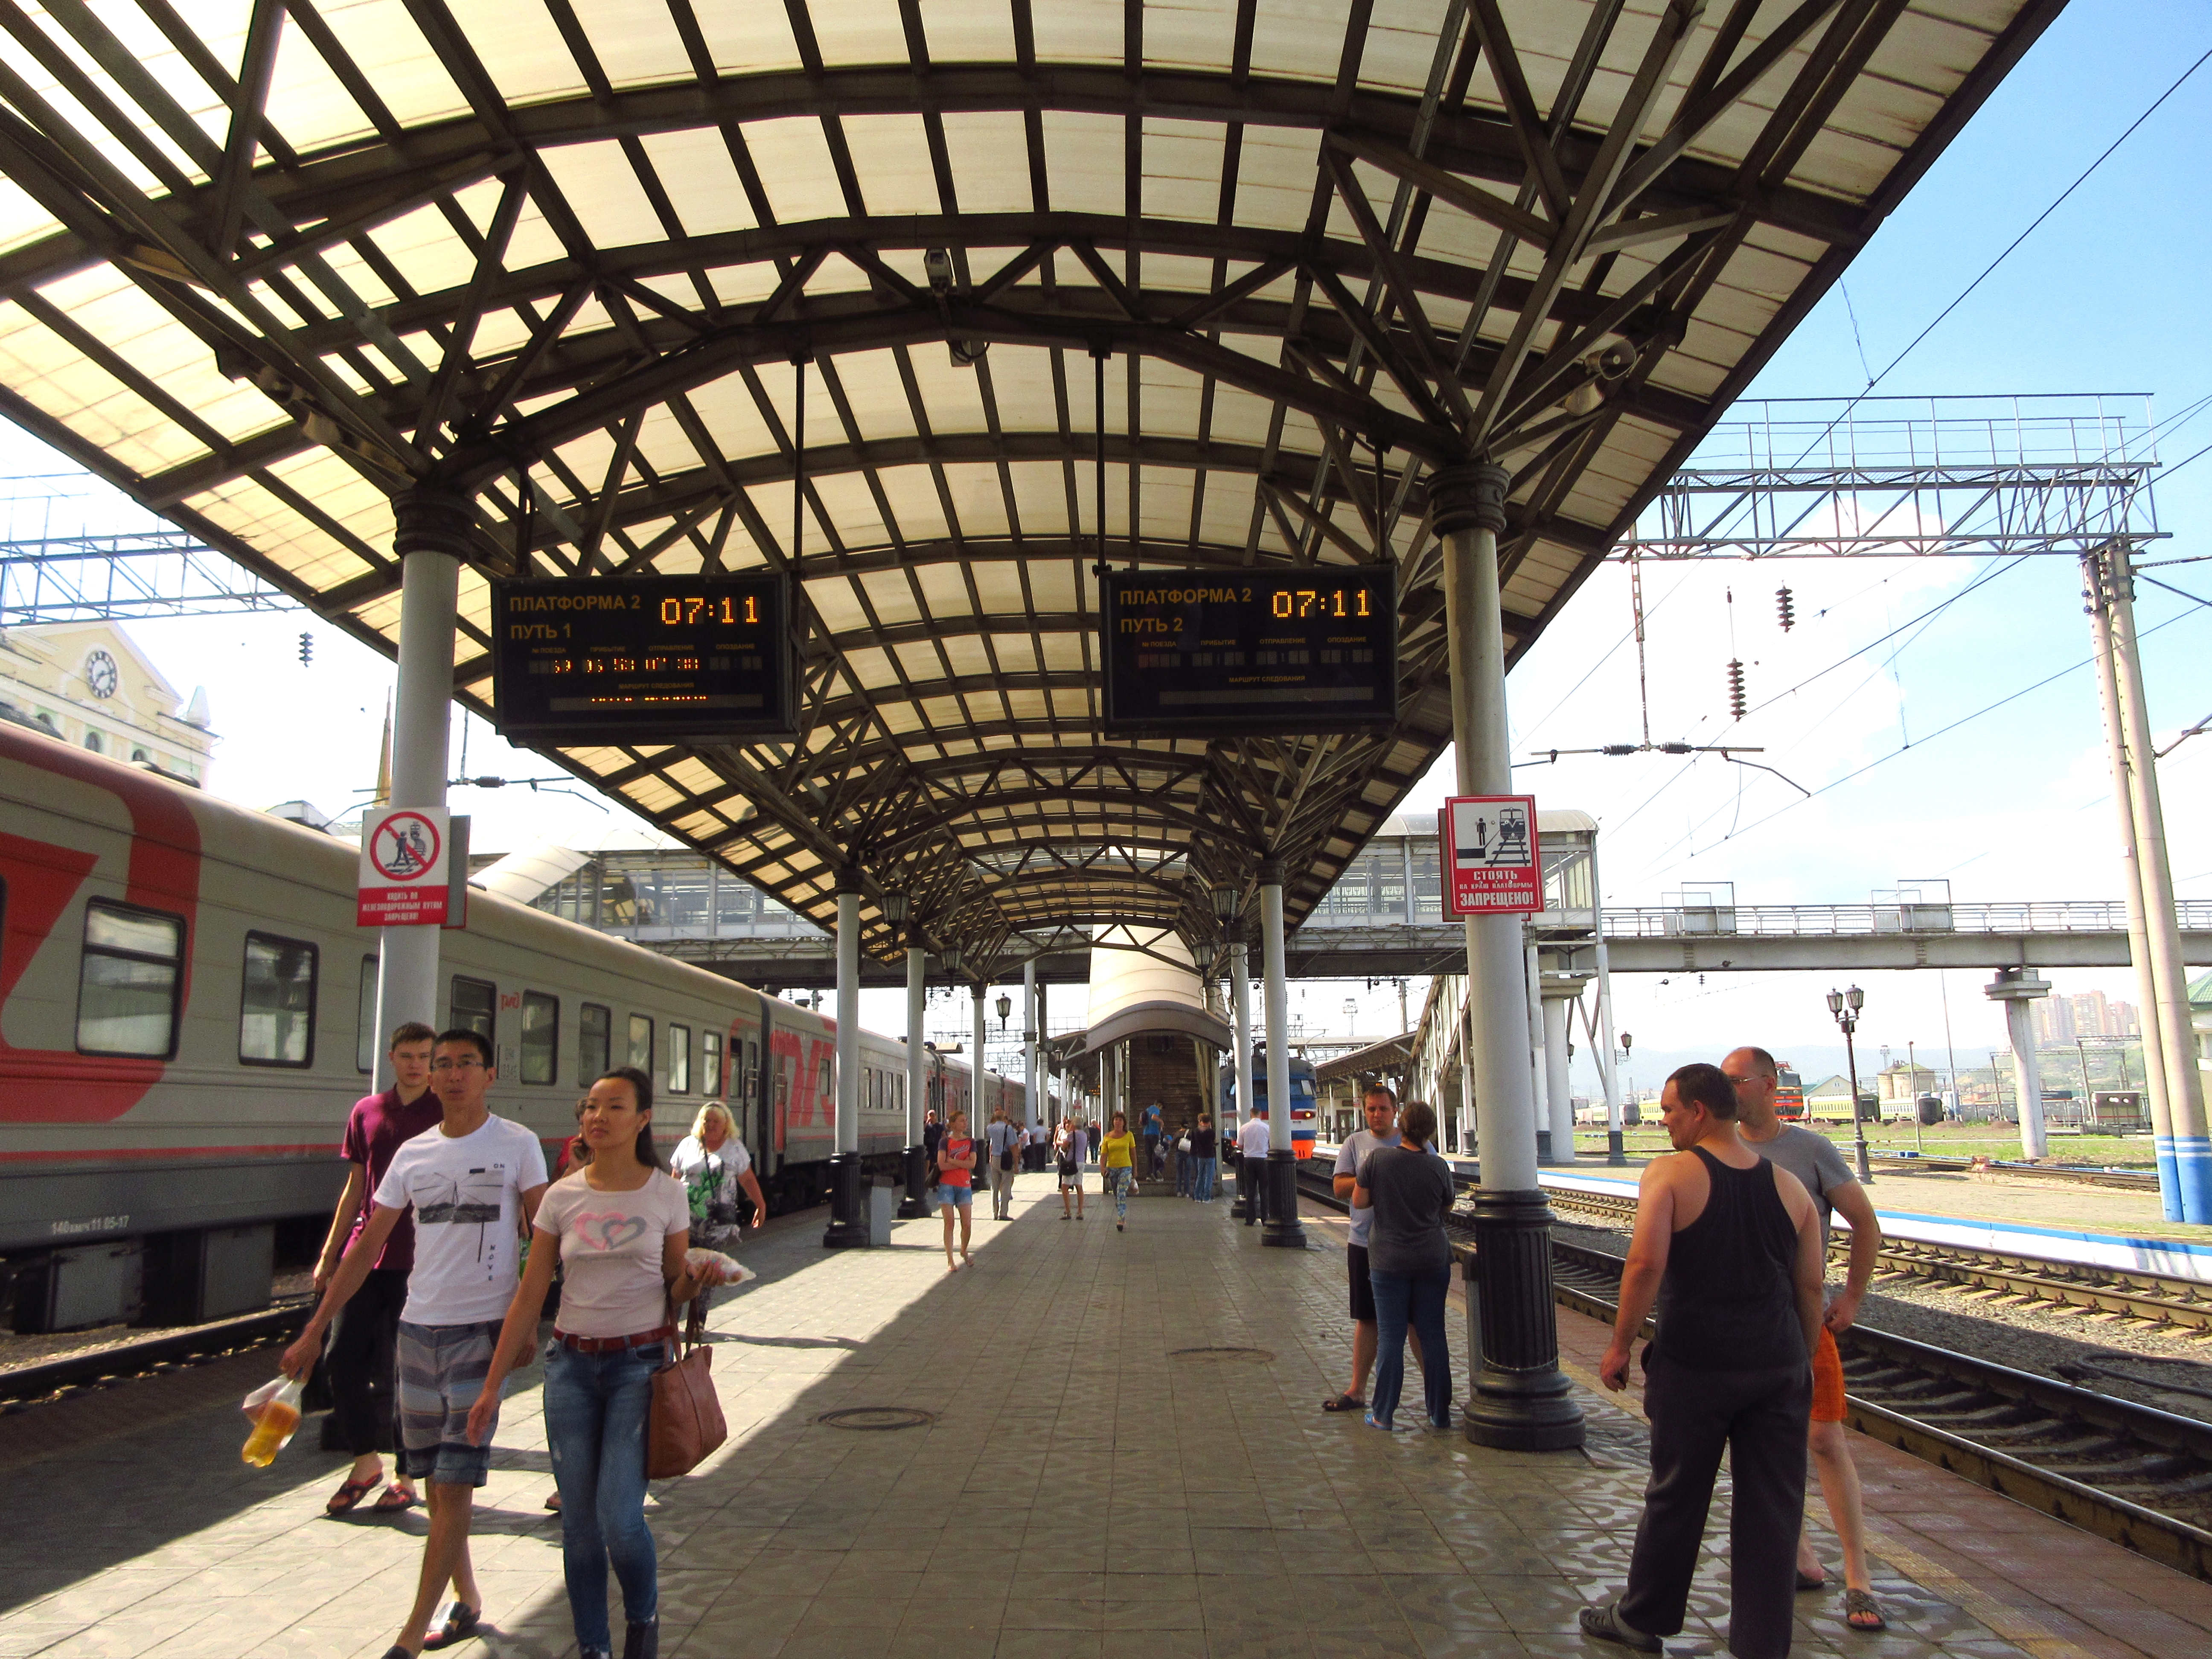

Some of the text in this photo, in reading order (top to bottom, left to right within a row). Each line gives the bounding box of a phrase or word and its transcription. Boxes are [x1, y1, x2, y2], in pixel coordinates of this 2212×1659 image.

[510, 595, 640, 611] ПЛАТФОРМА 2
[1120, 588, 1252, 605] ПЛАТФОРМА 2
[1273, 590, 1371, 617] 07:11
[661, 597, 758, 624] 07:11
[511, 623, 572, 639] ПУТЬ 1
[1121, 618, 1183, 633] ПУТЬ 2
[1473, 870, 1517, 880] СТОЯТЬ
[1460, 891, 1534, 907] ЗАПРЕЩЕНО!
